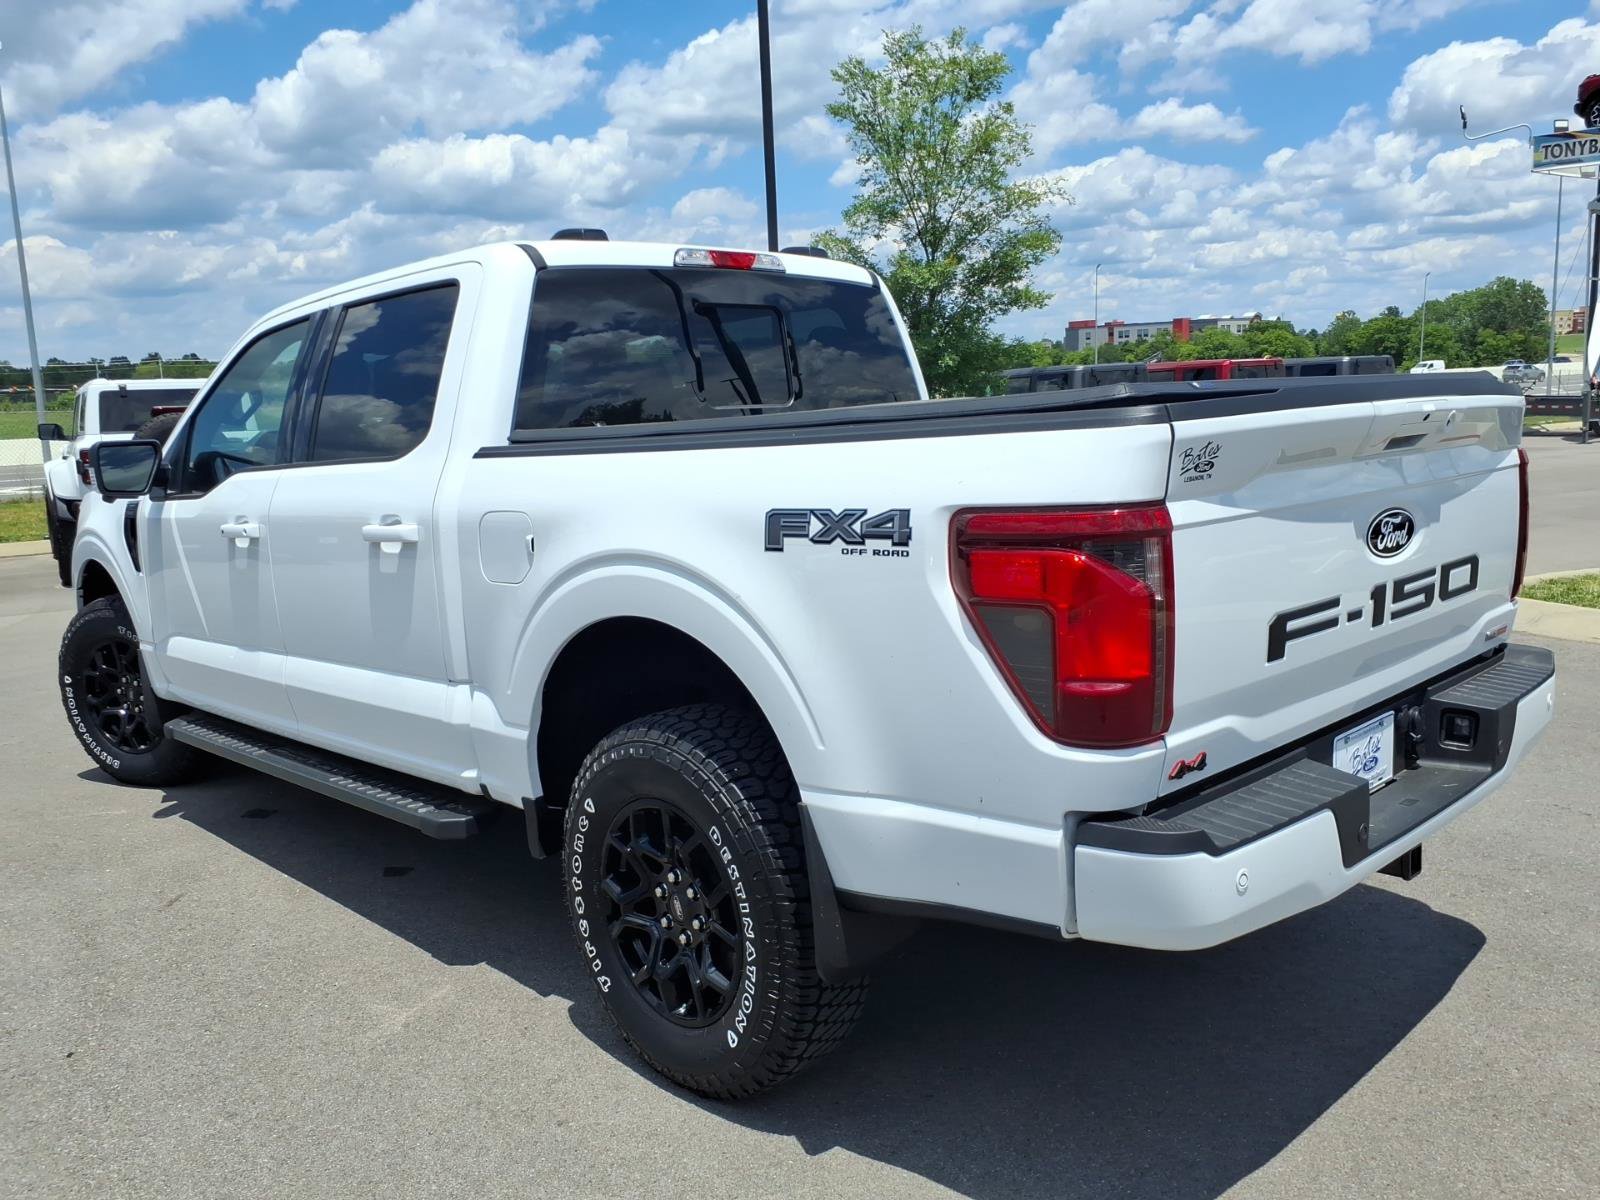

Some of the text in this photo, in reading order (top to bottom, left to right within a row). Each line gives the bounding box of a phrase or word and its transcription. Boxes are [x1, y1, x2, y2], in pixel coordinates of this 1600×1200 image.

[1541, 138, 1600, 160] TONYB
[765, 508, 911, 551] FX4
[873, 549, 909, 557] ROAD
[1378, 516, 1408, 549] Ford
[1267, 554, 1479, 663] F-150
[64, 688, 120, 769] DESTINATION
[573, 815, 611, 992] Firestone
[709, 826, 756, 1033] DESTINATION
